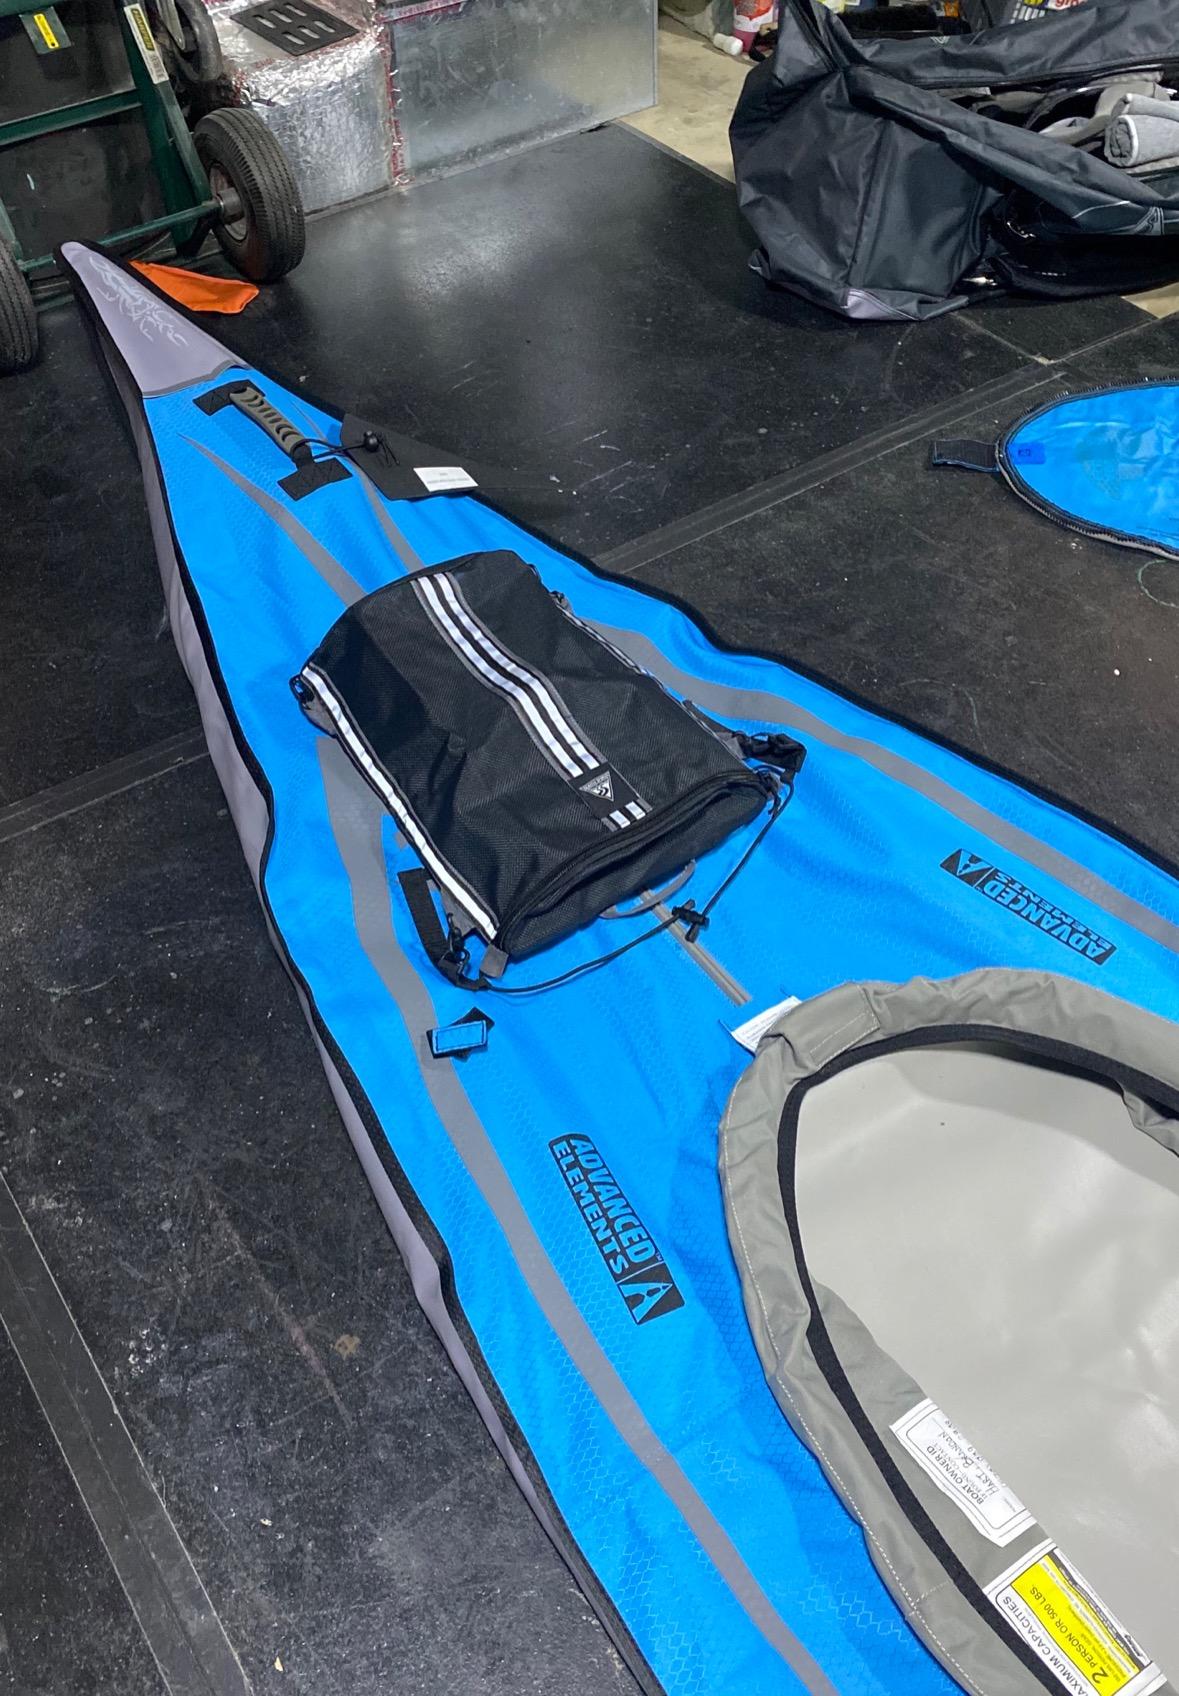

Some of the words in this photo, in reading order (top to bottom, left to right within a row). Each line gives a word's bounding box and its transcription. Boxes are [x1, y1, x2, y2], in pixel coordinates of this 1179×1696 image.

[984, 880, 1106, 958] ADVANCED
[995, 872, 1112, 949] ELEMENTS
[553, 1141, 629, 1274] ELEMENTS
[570, 1139, 655, 1264] ADVANCED
[925, 1444, 937, 1456] ID
[934, 1453, 963, 1484] OWNER
[961, 1482, 984, 1504] BOAT
[1001, 1594, 1052, 1655] CAPACITIES
[1042, 1602, 1058, 1620] 500
[1053, 1618, 1068, 1633] OR
[1065, 1631, 1098, 1667] PERSON
[1048, 1654, 1090, 1696] AXIMUM
[1089, 1666, 1109, 1685] 2
